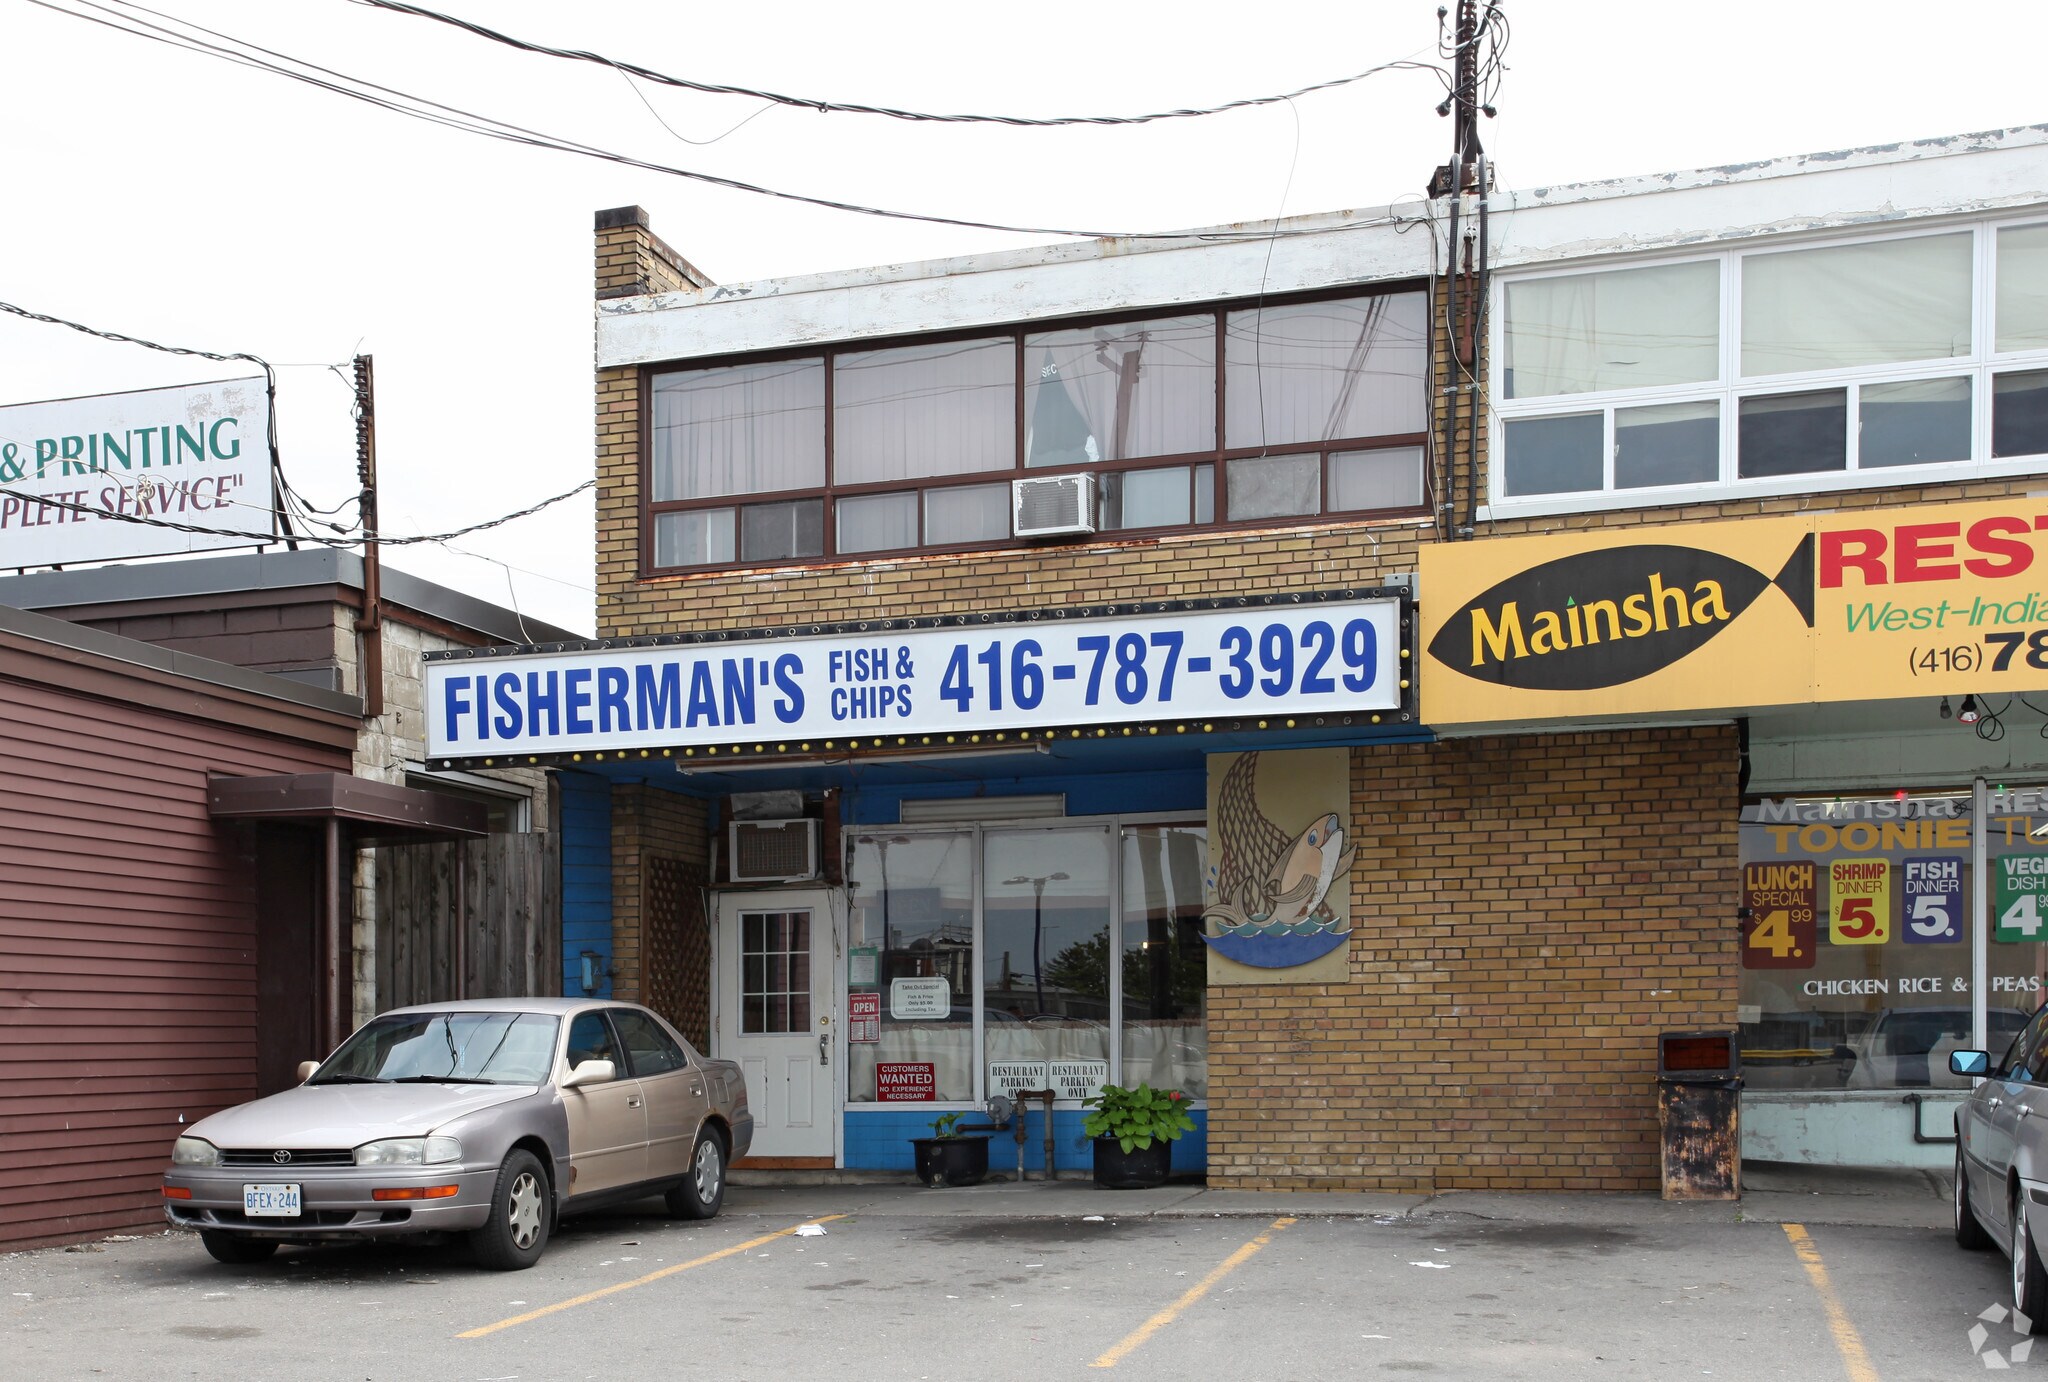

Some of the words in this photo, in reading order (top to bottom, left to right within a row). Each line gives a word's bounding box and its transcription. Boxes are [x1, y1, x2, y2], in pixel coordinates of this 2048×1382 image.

[0, 443, 27, 483] &
[36, 417, 240, 479] PRINTING
[1470, 572, 1731, 667] Mainsha
[829, 648, 888, 683] FISH
[895, 645, 915, 678] &
[940, 618, 1377, 712] 416-787-3929
[444, 653, 805, 742] FISHERMAN'S
[830, 684, 912, 721] CHIPS
[1757, 793, 1956, 822] Mainsha
[1766, 819, 1971, 853] TOONIE
[1747, 866, 1812, 891] LUNCH
[1833, 863, 1886, 880] SHRIMP
[1906, 862, 1957, 879] FISH
[1837, 881, 1882, 894] DINNER
[1906, 880, 1959, 893] DINNER
[2008, 876, 2046, 890] DISH
[1752, 892, 1808, 906] SPECIAL
[1803, 979, 1888, 996] CHICKEN
[1899, 977, 1941, 993] RICE
[1952, 976, 1967, 991] &
[1993, 976, 2040, 991] PEAS
[854, 1003, 875, 1013] OPEN
[992, 1066, 1043, 1076] RESTAURANT
[1052, 1065, 1104, 1075] RESTAURANT
[880, 1074, 932, 1084] WANTED
[1001, 1078, 1035, 1087] PARKING
[1060, 1077, 1095, 1086] PARKING
[1068, 1088, 1088, 1097] ONLY
